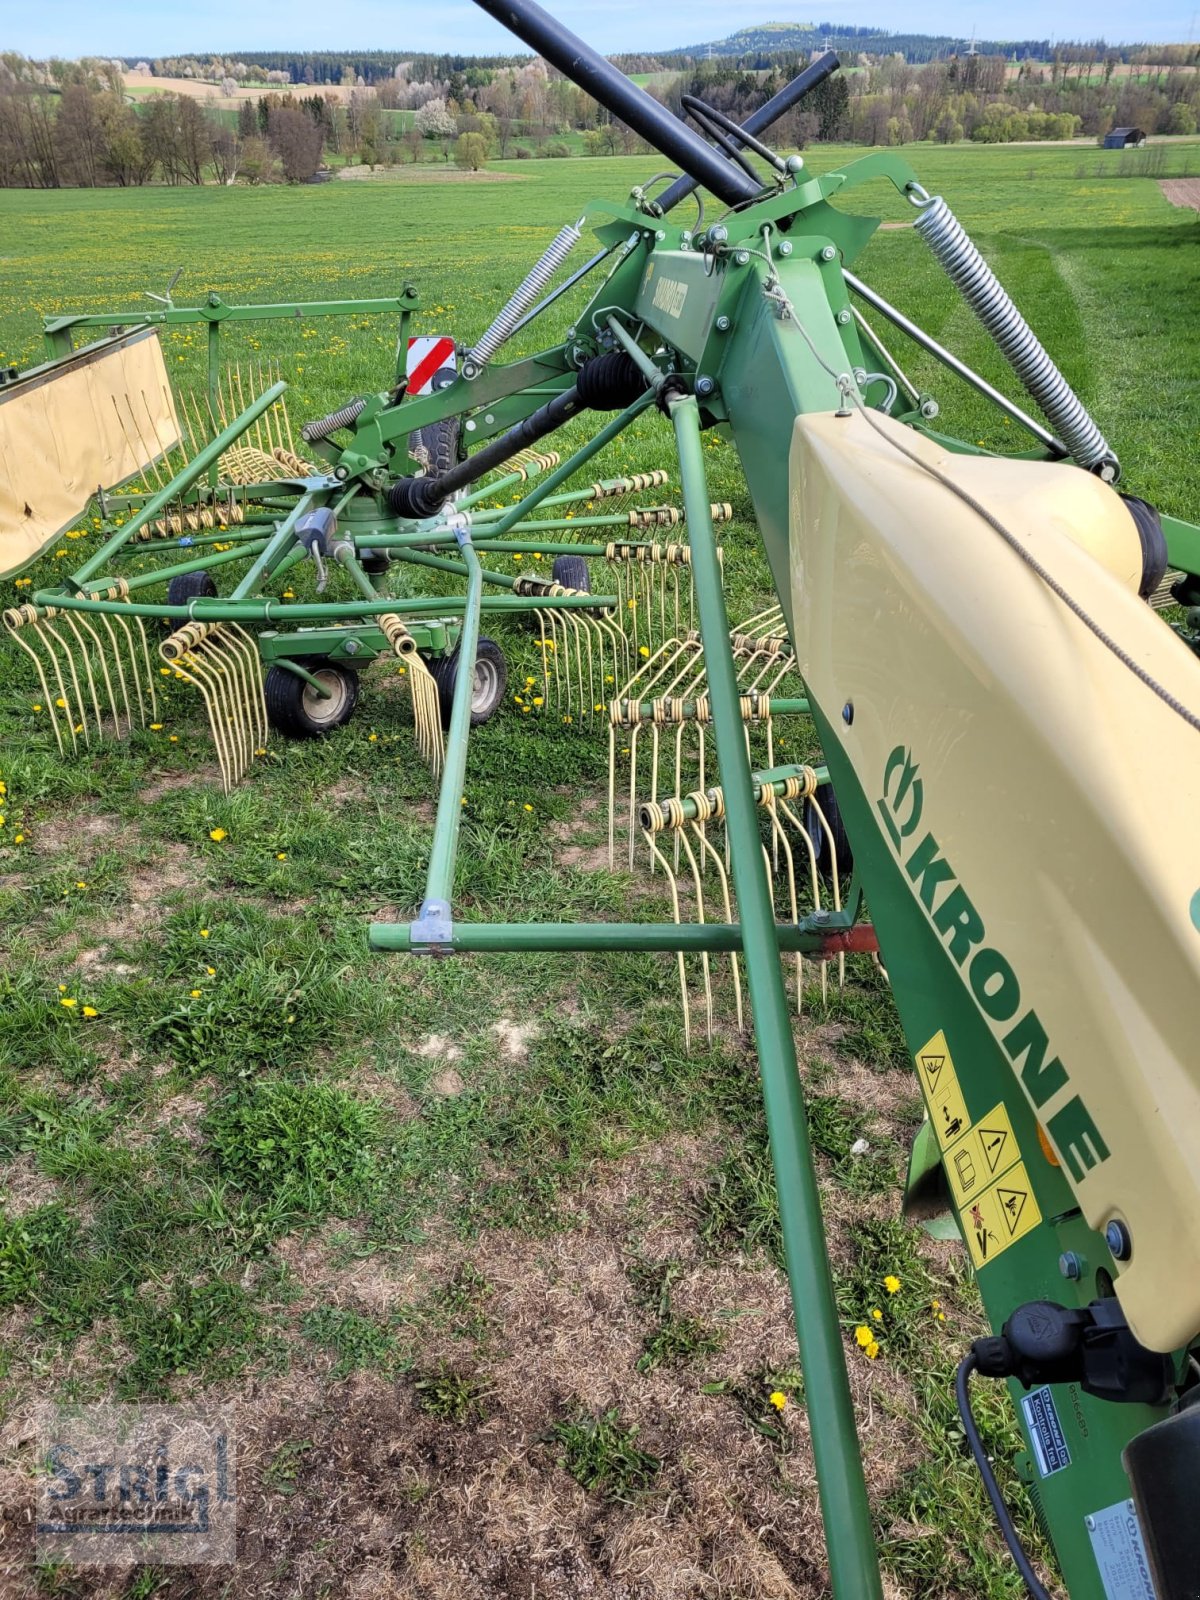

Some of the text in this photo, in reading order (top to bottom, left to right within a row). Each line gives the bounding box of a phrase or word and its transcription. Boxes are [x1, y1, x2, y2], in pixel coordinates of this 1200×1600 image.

[905, 831, 1111, 1184] KRONE
[1034, 1398, 1051, 1446] Kontrolle
[1046, 1403, 1063, 1447] KRONE
